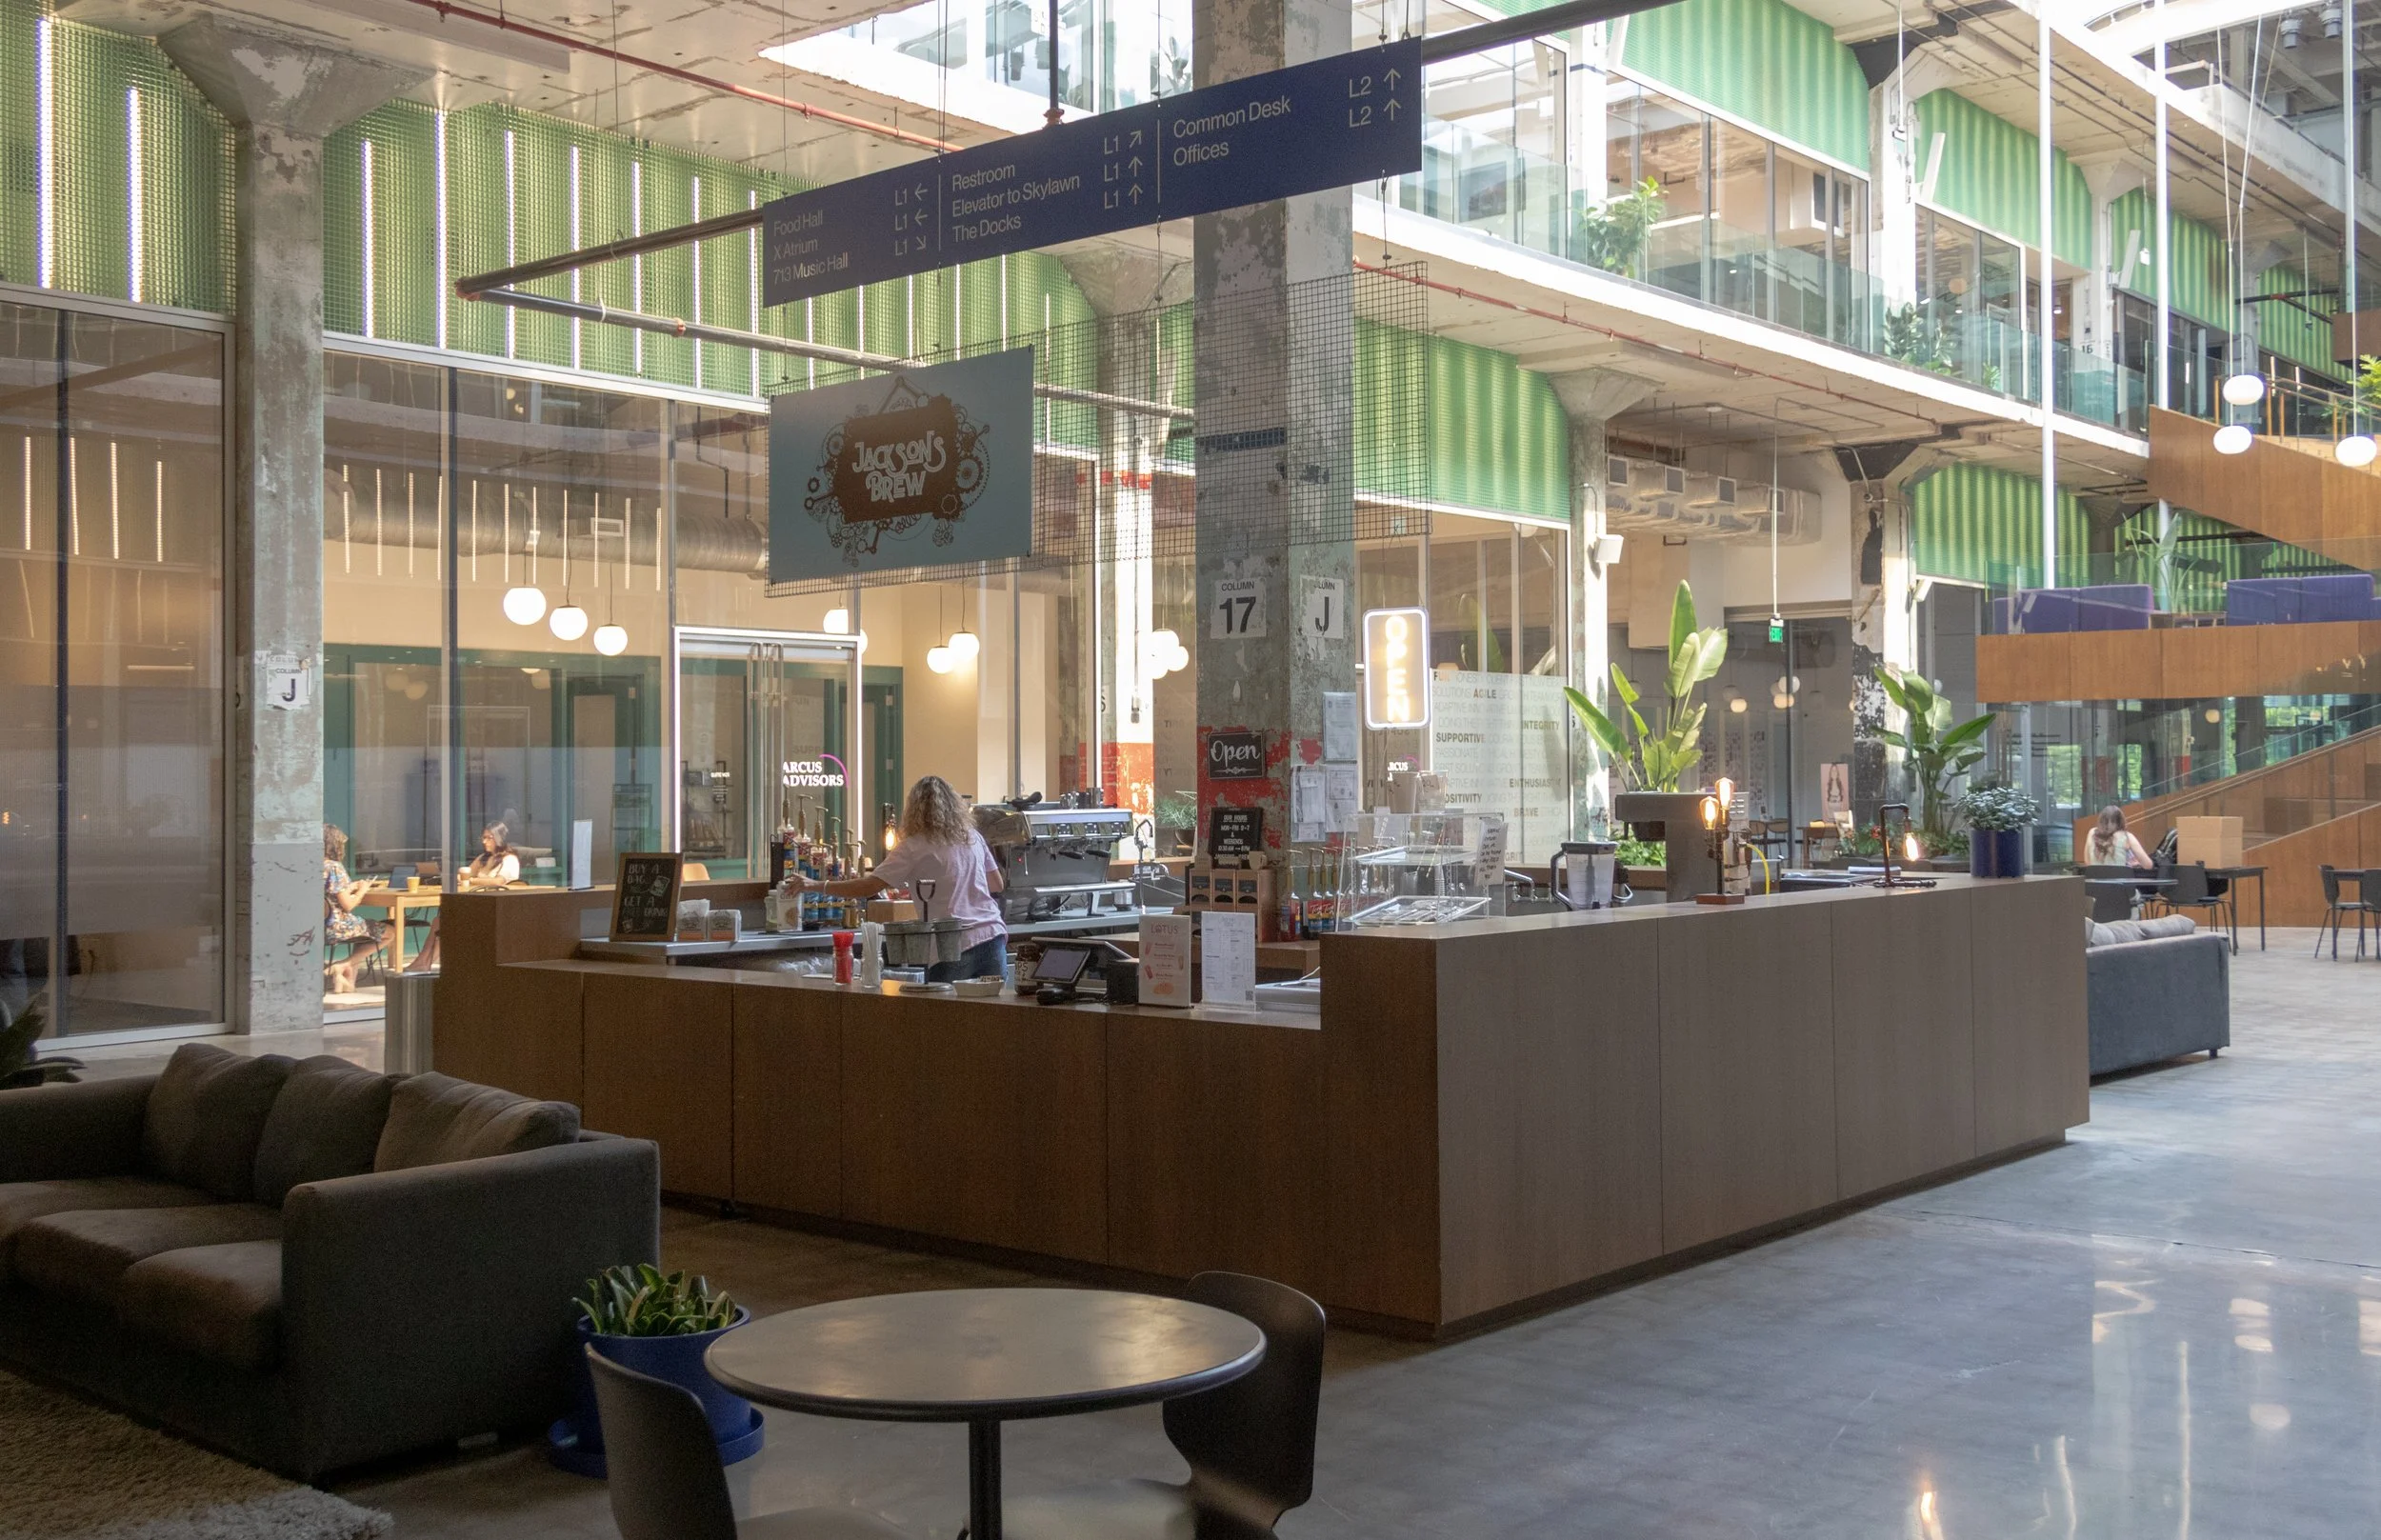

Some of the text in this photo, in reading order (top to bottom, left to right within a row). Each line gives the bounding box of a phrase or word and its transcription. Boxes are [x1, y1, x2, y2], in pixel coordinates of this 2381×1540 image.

[1349, 75, 1371, 98] L2
[1173, 95, 1291, 138] Common Desk
[1349, 106, 1371, 128] L2
[1103, 135, 1119, 155] L1
[1173, 142, 1230, 167] Offices
[952, 164, 1015, 191] Restroom
[1103, 162, 1119, 182] L1
[894, 189, 908, 207] L1
[952, 173, 1081, 218] Elevator to Skylawn
[1103, 190, 1119, 210] L1
[773, 210, 824, 238] Food Hall
[894, 213, 908, 231] L1
[952, 214, 1022, 243] The Docks
[773, 236, 818, 262] X Atrium
[894, 239, 908, 257] L1
[773, 251, 849, 286] 713 Music Hall
[851, 430, 947, 477] JACKSON'S
[866, 471, 927, 503] BREW
[1221, 581, 1255, 592] COLUMN
[1219, 596, 1256, 635] 17
[1315, 596, 1330, 632] J
[1385, 614, 1411, 724] OPEN
[282, 678, 296, 703] J
[1435, 732, 1486, 744] SUPPORTIVE
[1211, 740, 1260, 768] Open
[783, 761, 823, 774] ARCUS
[783, 773, 845, 788] ADVISORS
[1445, 793, 1483, 804] OSITIVITY
[629, 863, 659, 874] BUY A
[1150, 923, 1179, 934] LOTUS
